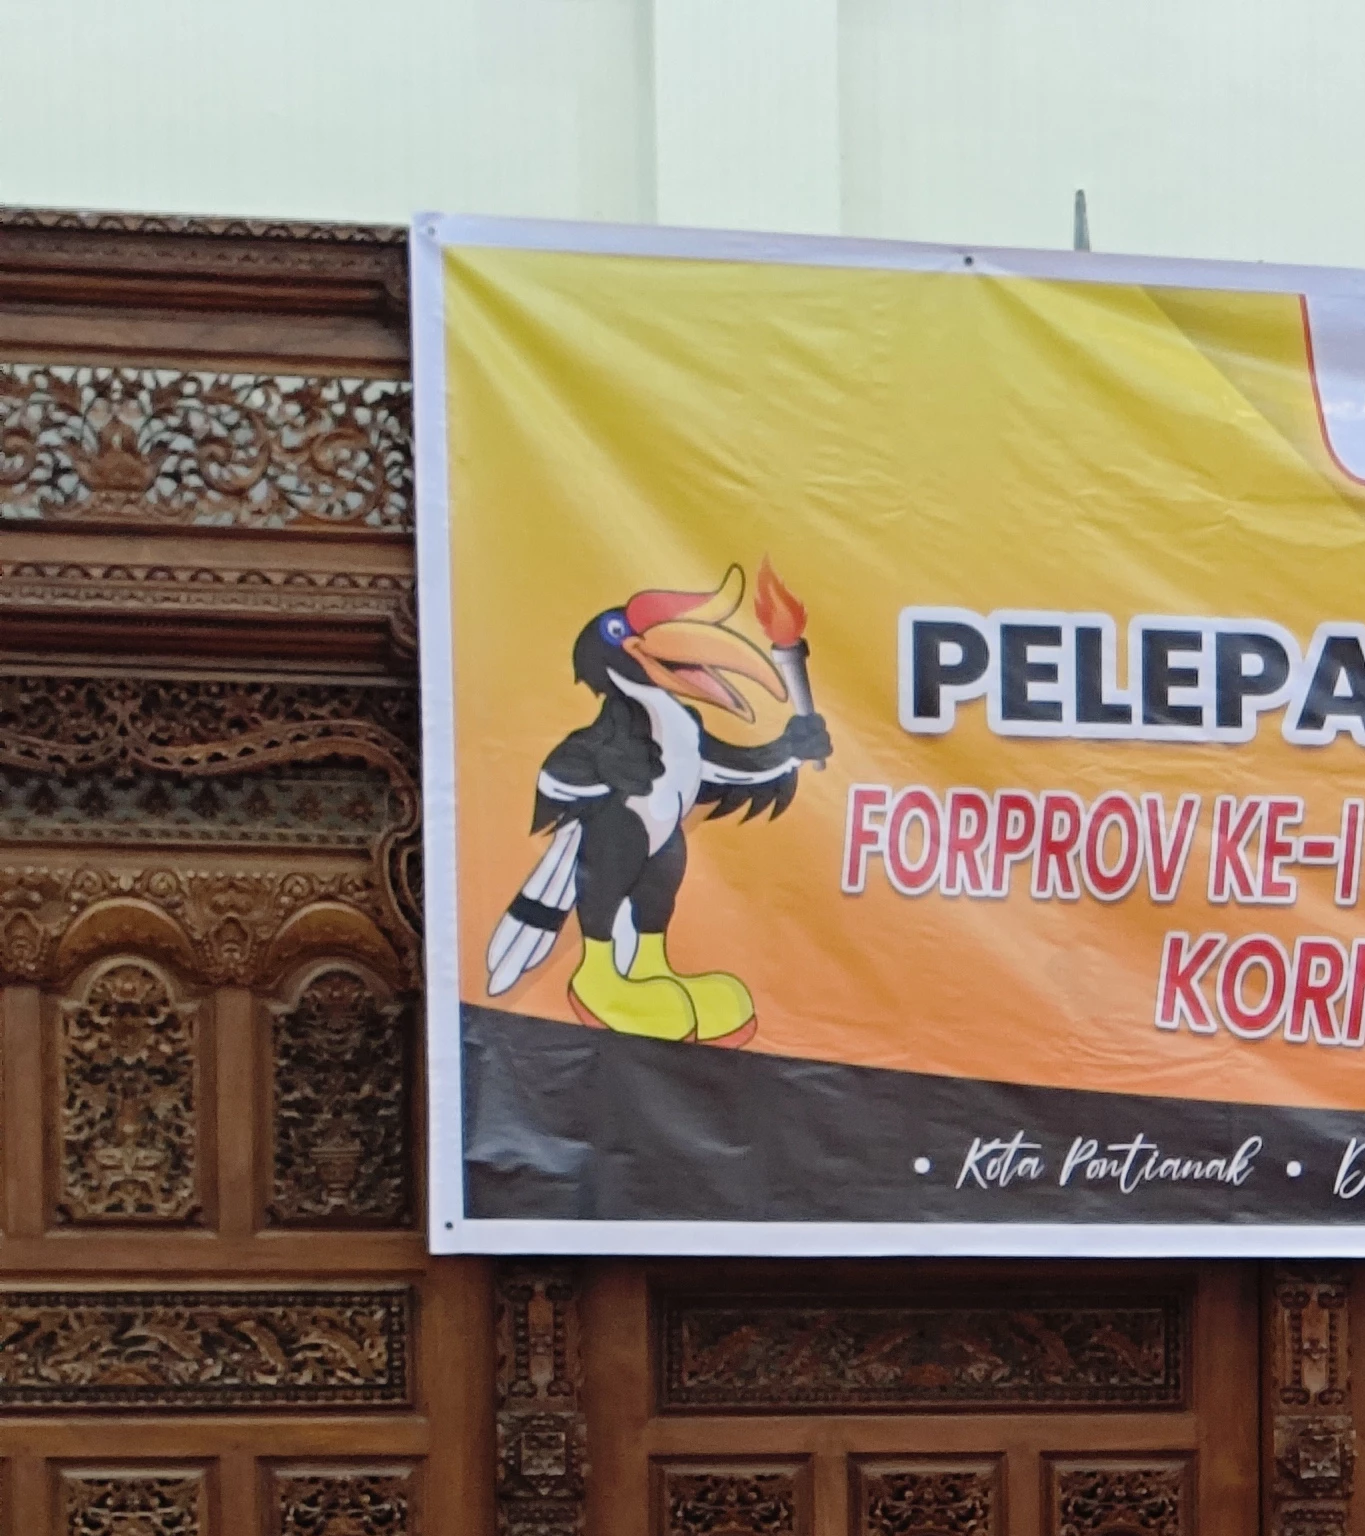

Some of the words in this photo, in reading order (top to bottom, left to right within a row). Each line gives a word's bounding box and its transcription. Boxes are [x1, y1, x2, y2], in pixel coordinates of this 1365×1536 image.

[844, 786, 1197, 902] FORPROV
[1210, 798, 1364, 905] KE-I
[956, 1130, 1044, 1189] Kota
[1059, 1132, 1263, 1194] Pontianak
